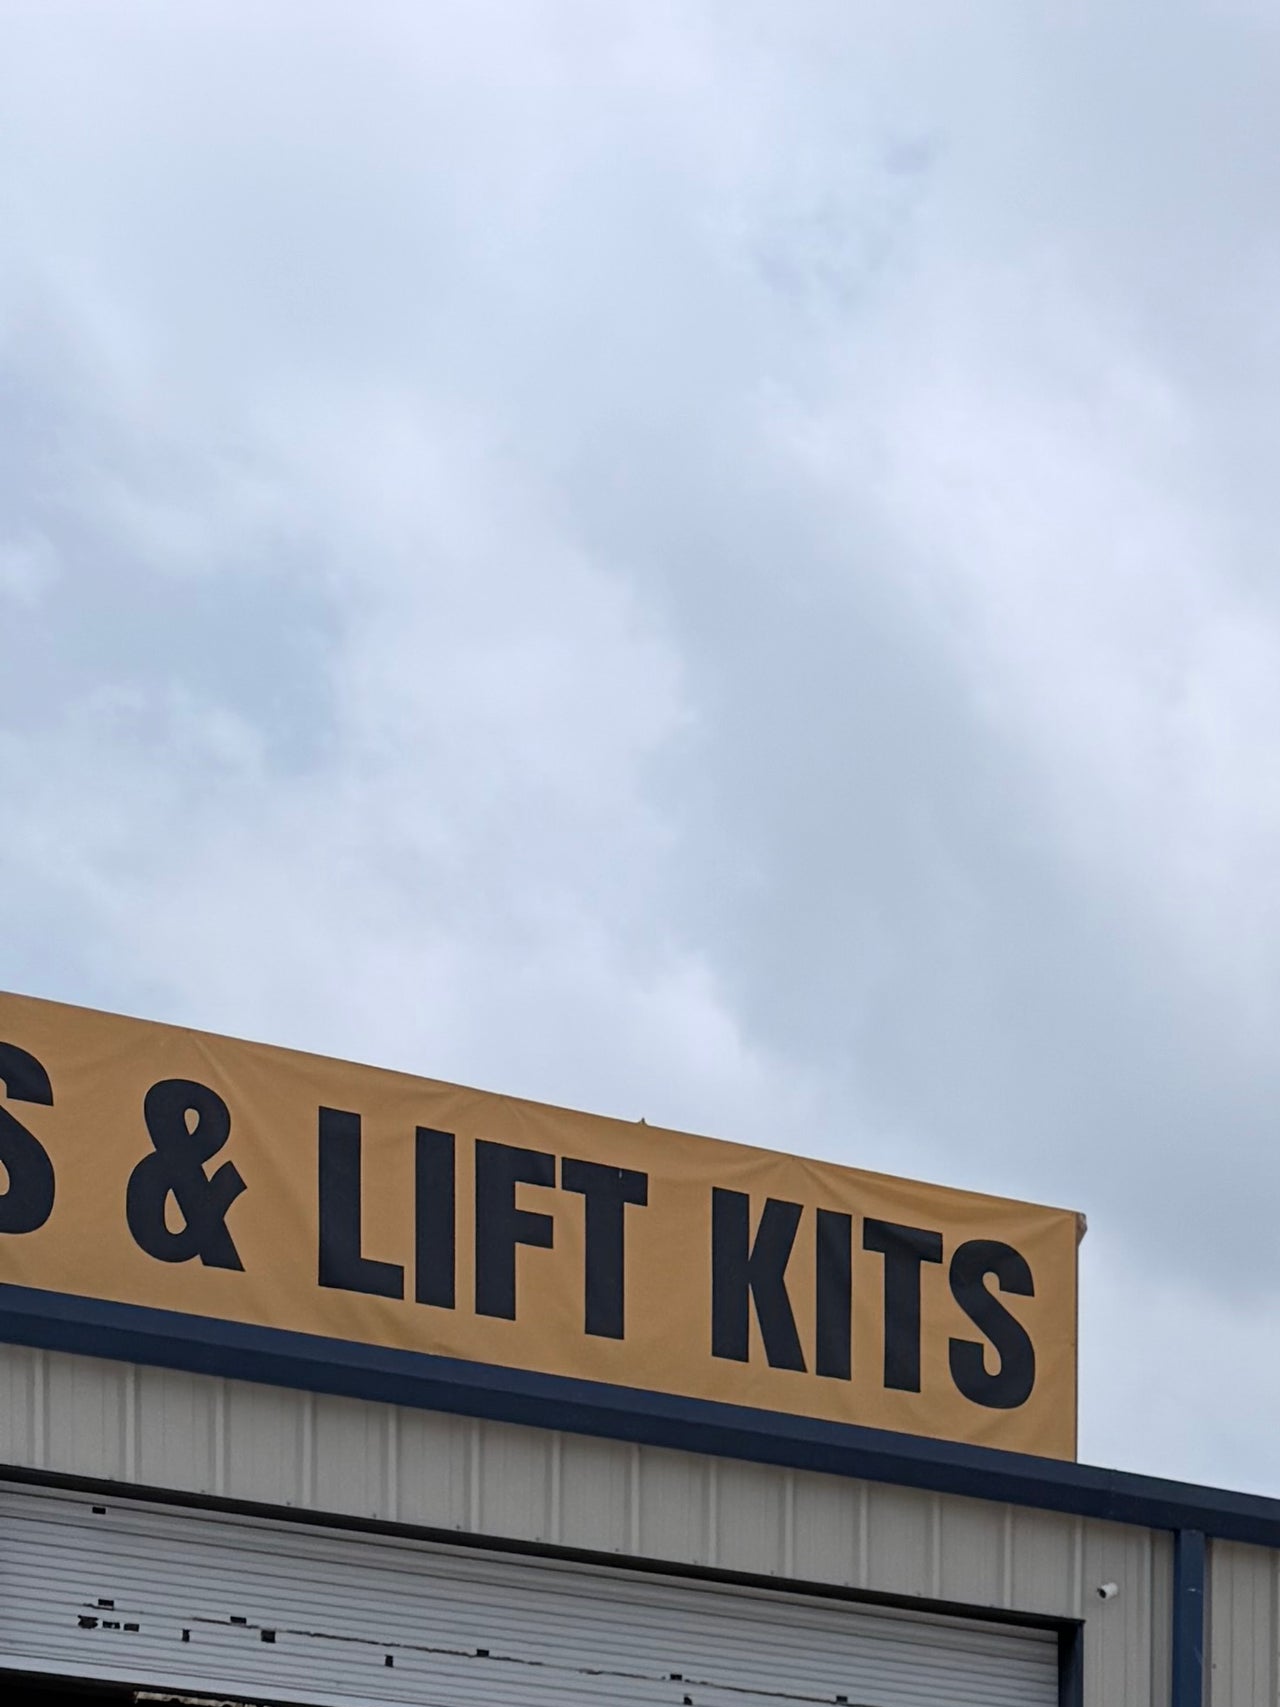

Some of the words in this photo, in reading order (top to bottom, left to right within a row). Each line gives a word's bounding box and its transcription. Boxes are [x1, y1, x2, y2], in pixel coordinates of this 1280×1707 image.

[126, 1077, 248, 1272] &
[318, 1105, 649, 1341] LIFT
[711, 1186, 1036, 1409] KITS
